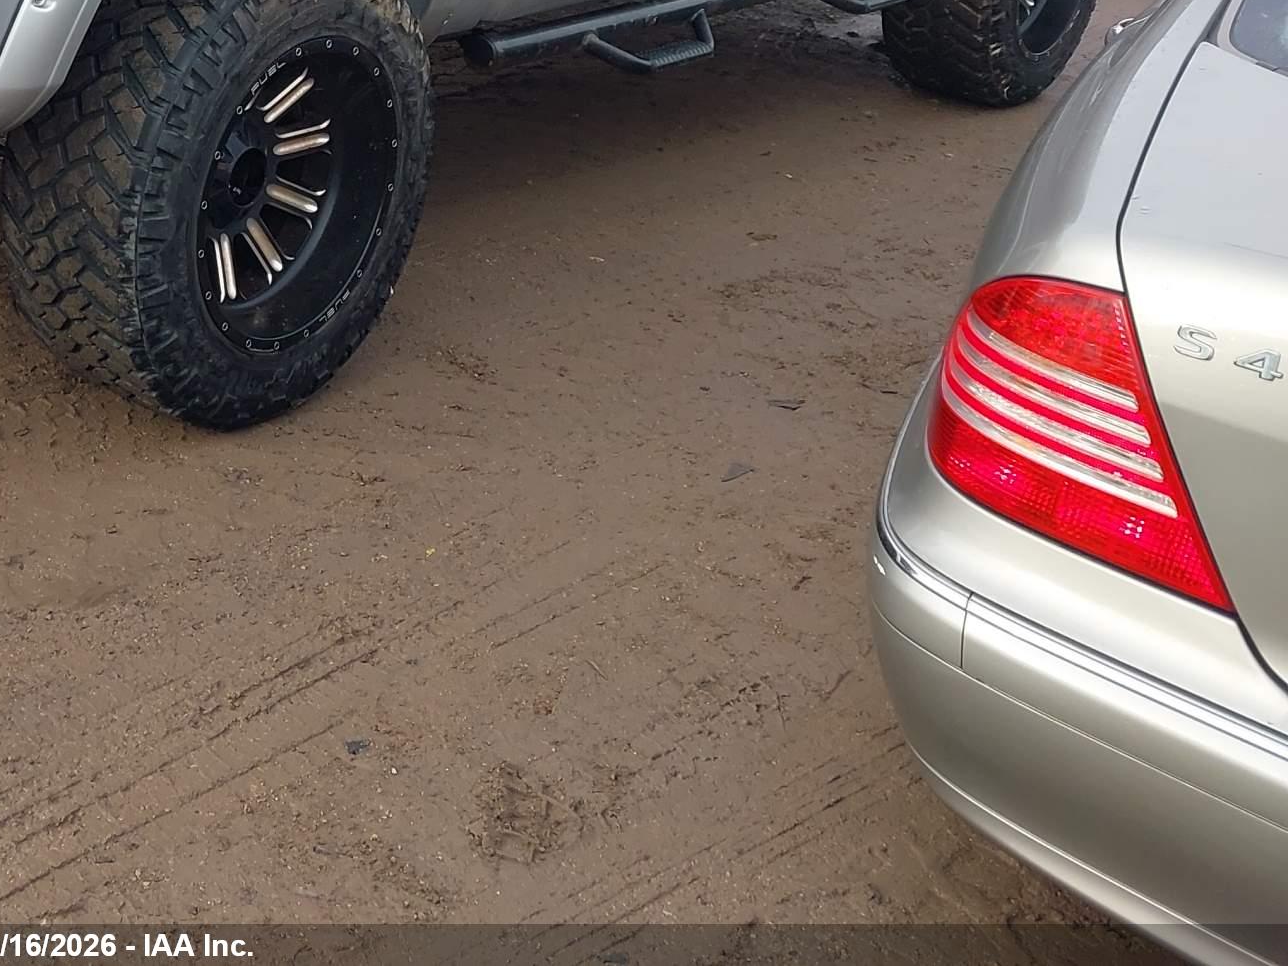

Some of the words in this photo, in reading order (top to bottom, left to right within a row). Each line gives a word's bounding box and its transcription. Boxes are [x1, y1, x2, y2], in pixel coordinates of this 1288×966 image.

[251, 62, 286, 96] FUEL
[319, 289, 350, 322] FUEL
[1173, 324, 1217, 361] S
[1233, 348, 1284, 381] 4
